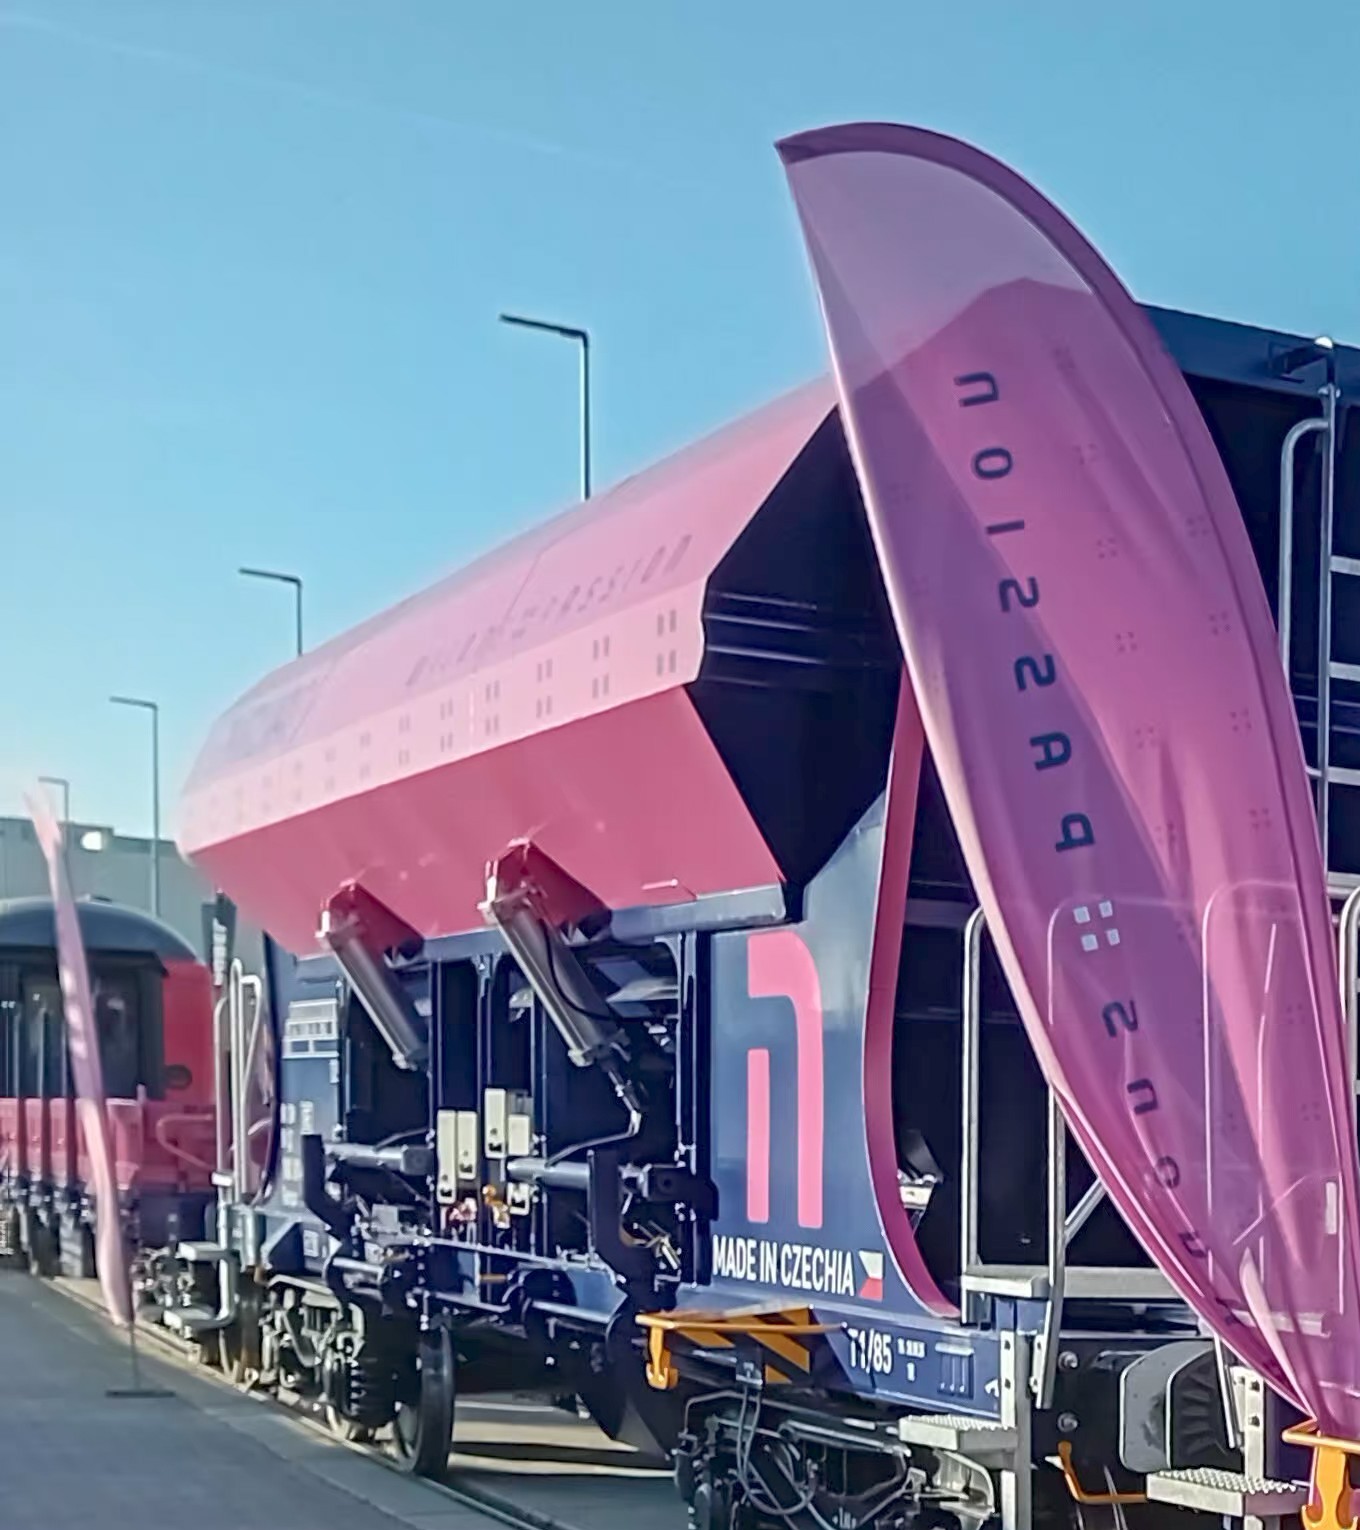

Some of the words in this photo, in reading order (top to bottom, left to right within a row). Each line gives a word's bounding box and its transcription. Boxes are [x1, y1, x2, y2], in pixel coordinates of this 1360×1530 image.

[712, 1235, 756, 1280] MADE
[759, 1244, 777, 1283] IN
[780, 1243, 855, 1297] CZECHIA
